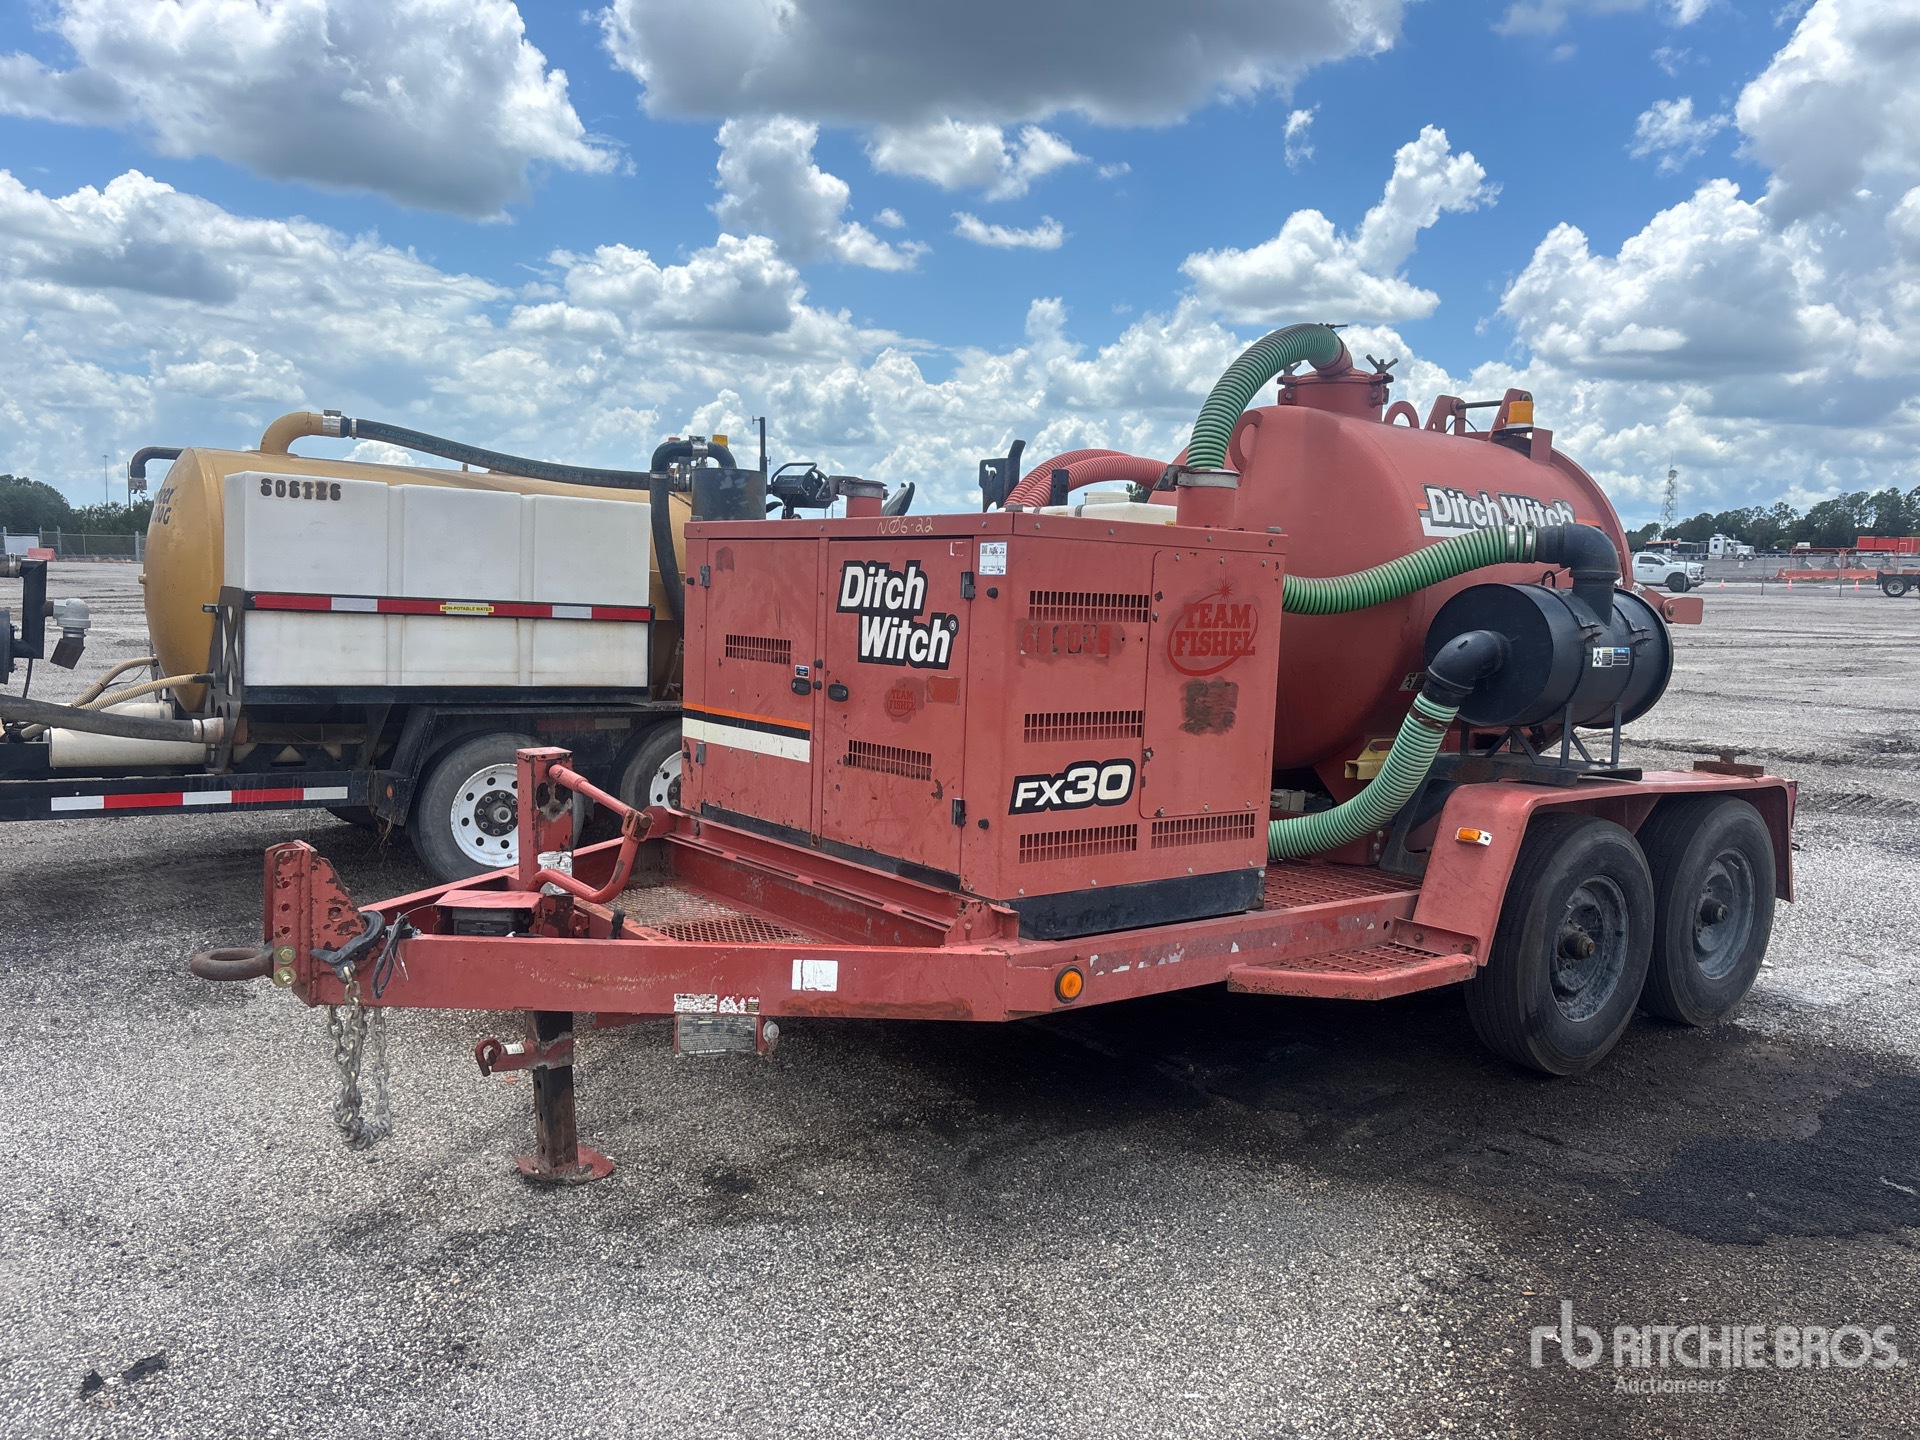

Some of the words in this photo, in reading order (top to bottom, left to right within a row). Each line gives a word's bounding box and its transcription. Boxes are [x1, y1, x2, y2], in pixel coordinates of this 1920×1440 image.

[1426, 487, 1502, 526] Ditch
[840, 566, 925, 610] Ditch
[1183, 603, 1252, 629] TEAM
[1174, 630, 1256, 656] FISHEL
[891, 689, 914, 700] TEAM
[1015, 764, 1132, 808] FX30
